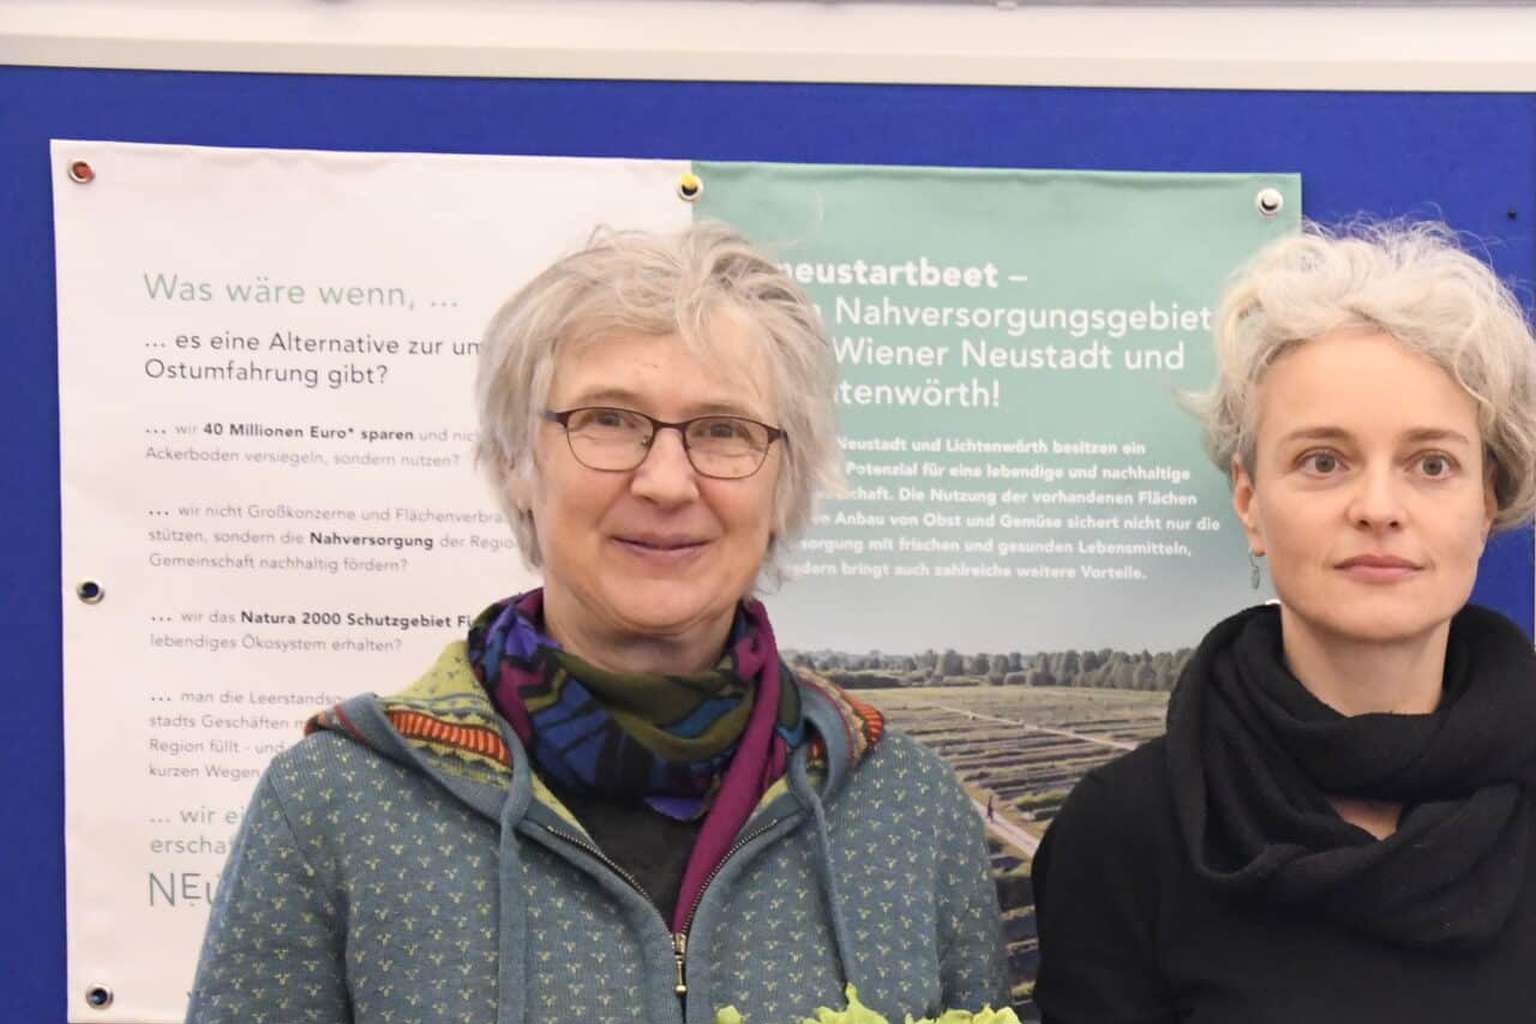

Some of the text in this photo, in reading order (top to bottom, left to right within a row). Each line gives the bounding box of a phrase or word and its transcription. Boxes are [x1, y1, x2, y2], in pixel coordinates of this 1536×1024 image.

[144, 274, 212, 301] Was
[226, 276, 305, 304] wäre
[319, 287, 416, 310] wenn,
[836, 296, 1213, 337] Nahversorgungsgebiet
[176, 336, 201, 349] es
[210, 332, 259, 350] eine
[269, 332, 399, 354] Alternative
[409, 341, 443, 355] zur
[833, 336, 1184, 370] Wiener Neustadt und
[145, 358, 388, 389] Ostumfahrung gibt?
[204, 423, 223, 435] 40
[230, 424, 303, 438] Millionen
[361, 431, 413, 442] sparen
[420, 428, 448, 441] und
[241, 611, 295, 624] Natura
[302, 612, 341, 625] 2000
[347, 613, 451, 631] Schutzgebiet
[149, 764, 260, 780] kurzen Wegen
[150, 835, 228, 854] erscha
